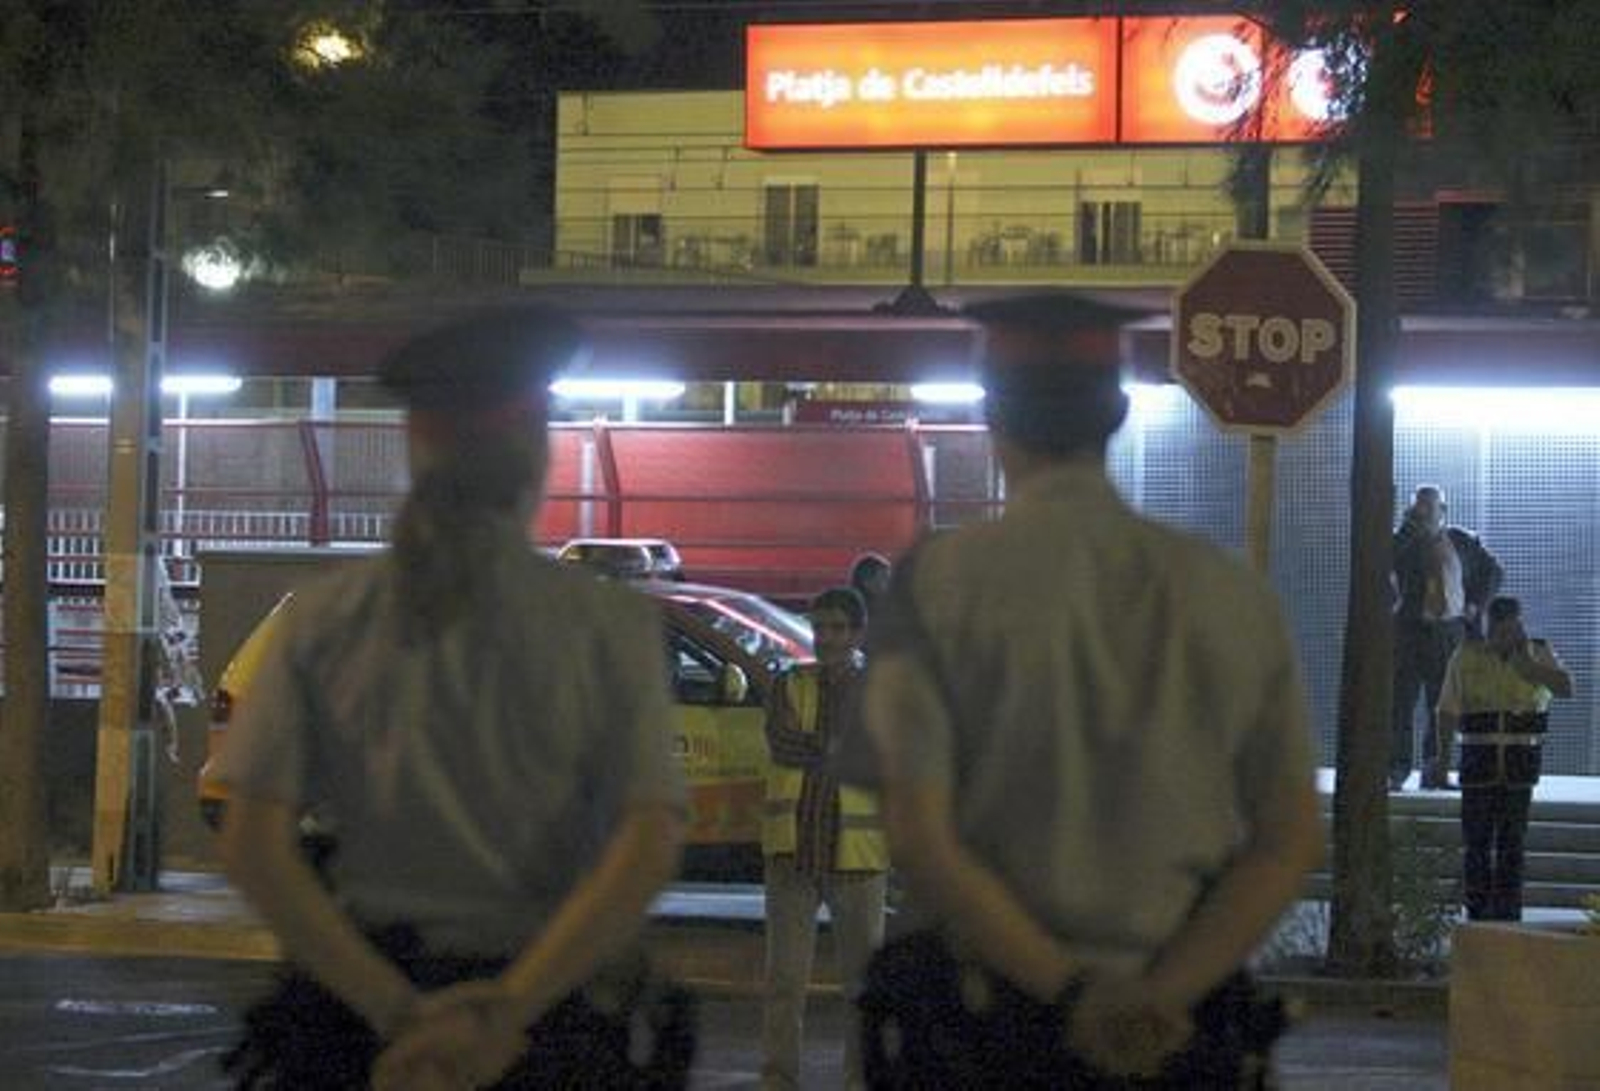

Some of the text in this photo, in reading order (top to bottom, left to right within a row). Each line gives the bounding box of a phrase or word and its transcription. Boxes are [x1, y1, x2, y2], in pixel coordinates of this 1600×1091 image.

[765, 63, 1095, 108] Platja de Castelldefels
[1187, 312, 1336, 364] STOP
